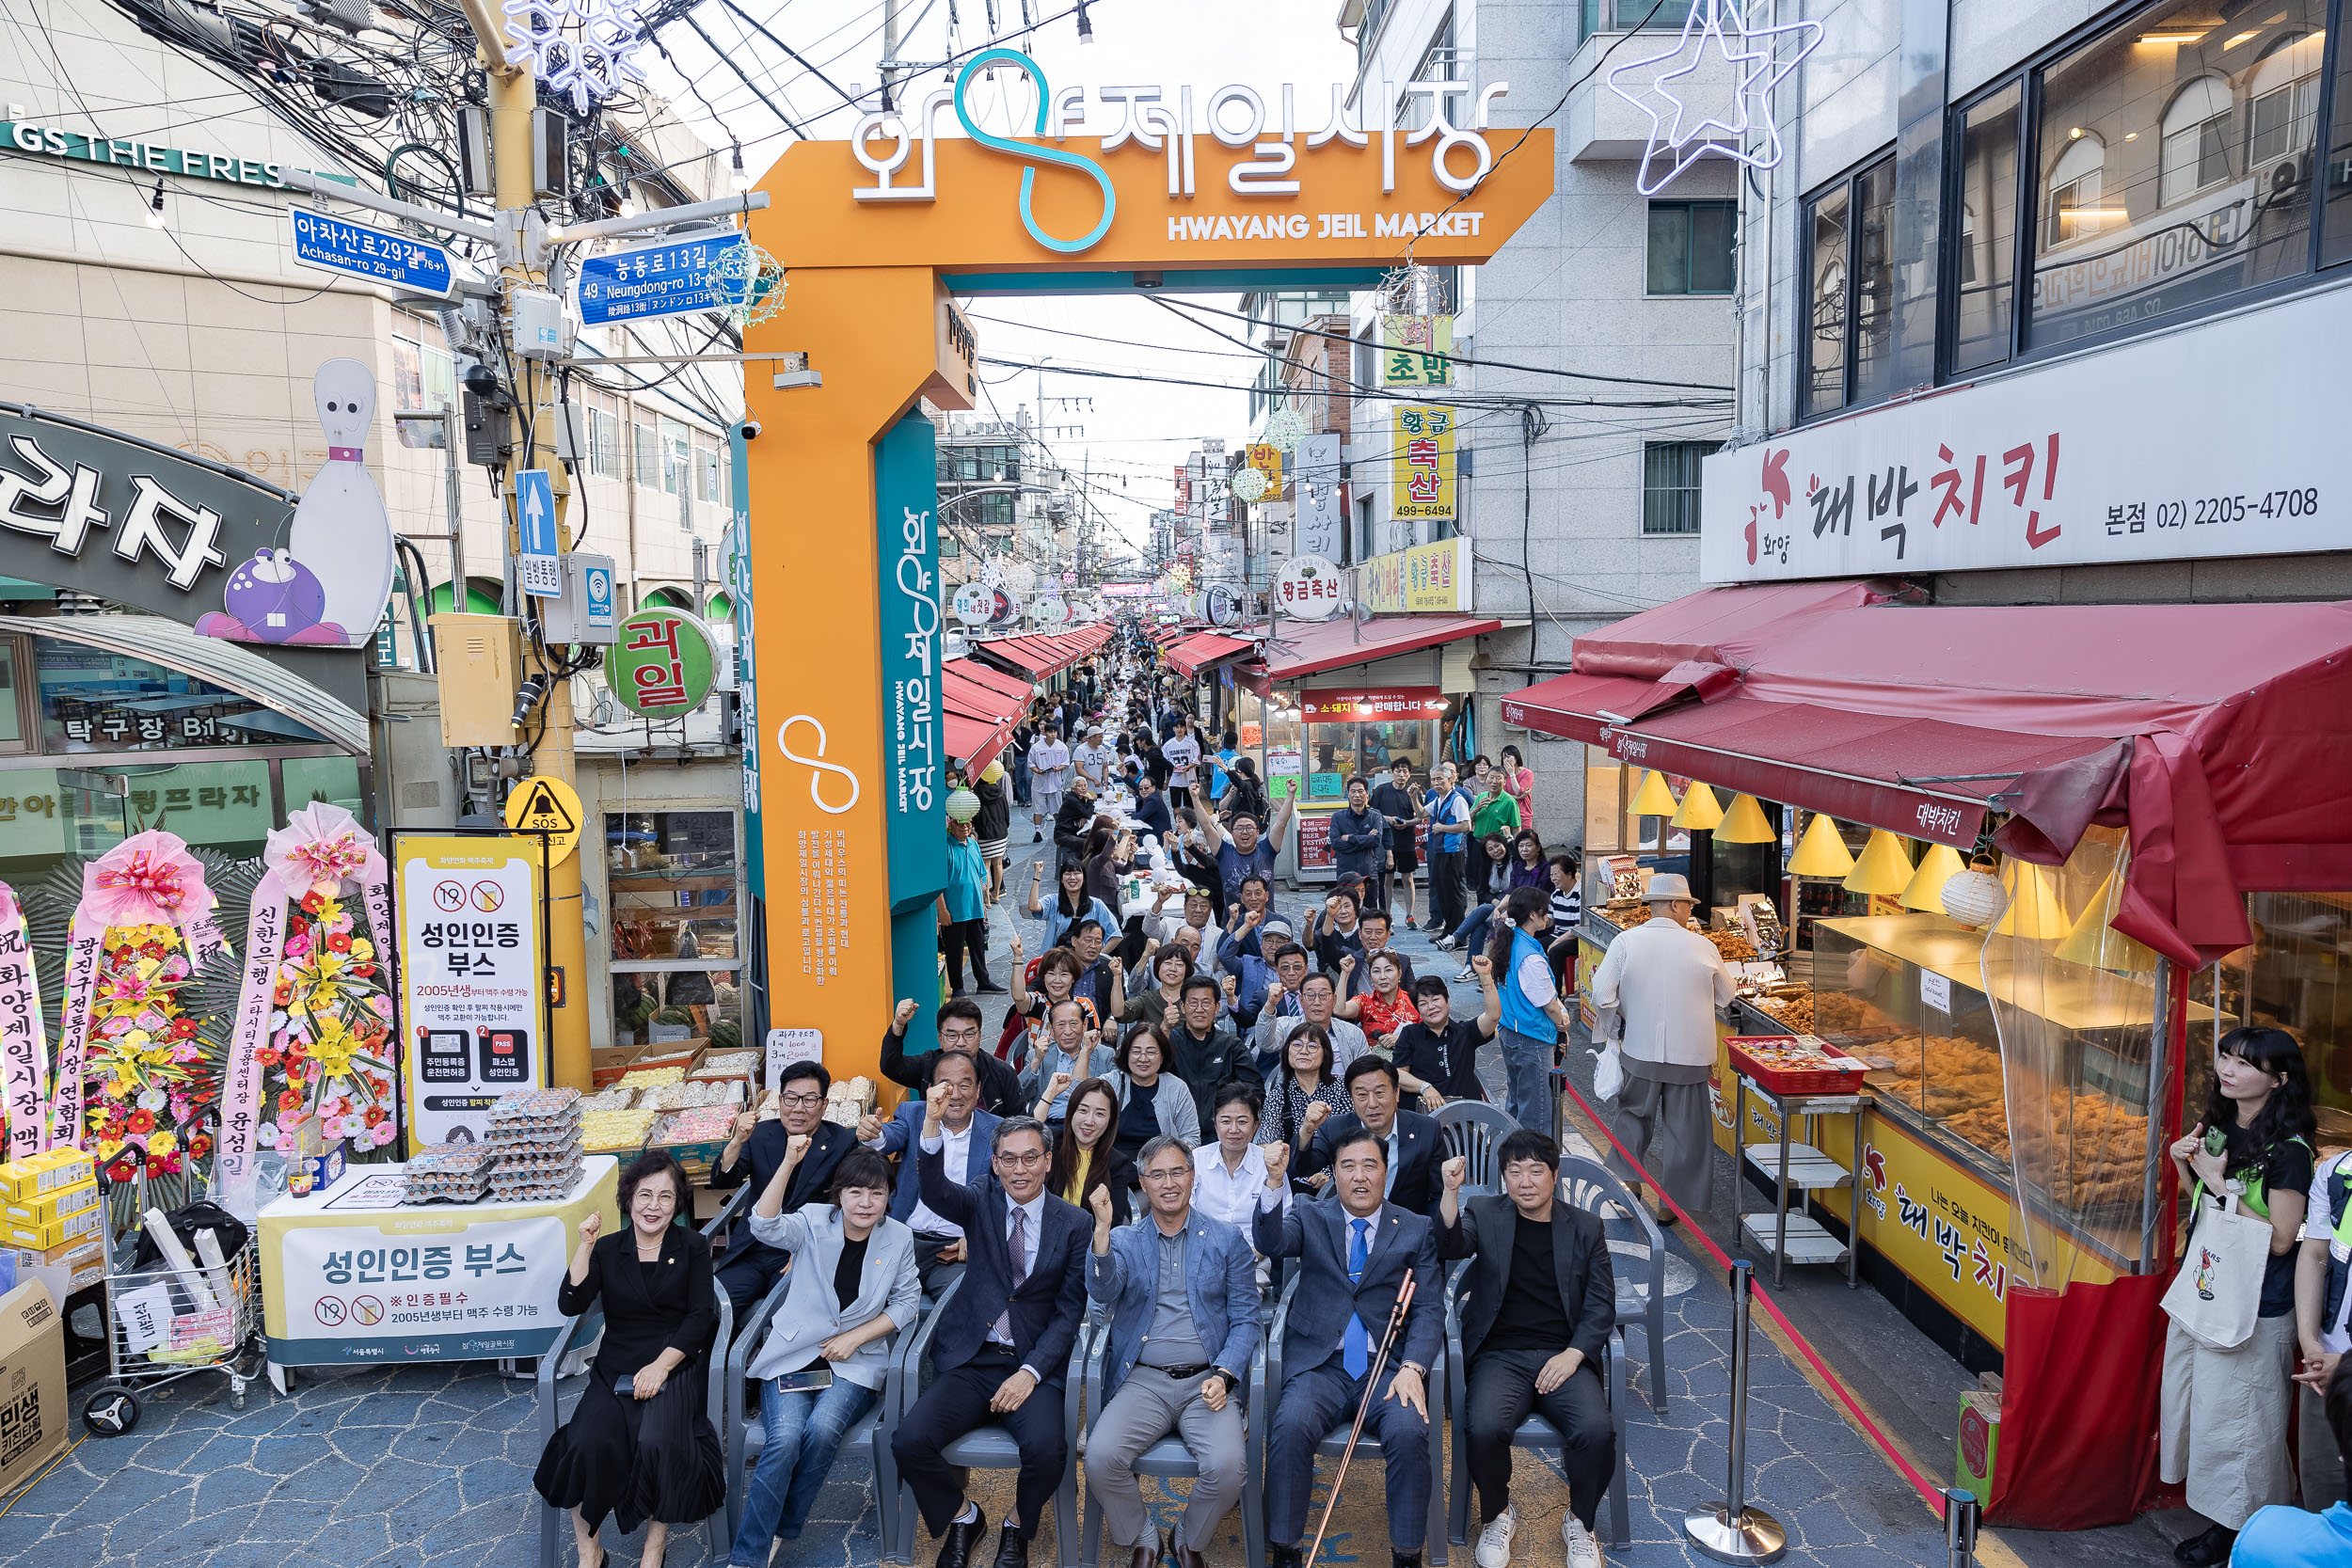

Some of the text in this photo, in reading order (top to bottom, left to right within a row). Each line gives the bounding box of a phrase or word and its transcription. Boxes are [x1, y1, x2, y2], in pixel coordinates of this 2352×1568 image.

[12, 122, 69, 155] GS
[77, 131, 170, 171] THE
[850, 48, 1509, 255] 화양제일시장
[1168, 212, 1484, 241] HWAYANG JEIL MARKET
[297, 217, 420, 270] 아차산로29길
[301, 243, 405, 279] Achasan-ro 29-gil
[615, 245, 741, 281] 능동로13길 53
[584, 282, 598, 299] 49
[606, 273, 684, 300] Neungdong-ro
[1387, 350, 1450, 385] 초밥
[1401, 409, 1450, 436] 황금
[1407, 438, 1441, 503] 축산
[1397, 505, 1452, 516] 499-6494
[1805, 432, 2061, 560] 대박치킨
[2105, 487, 2318, 535] 본점 02) 2205-4708
[1763, 533, 1790, 564] 화양
[525, 559, 557, 587] 일방통행
[1411, 548, 1453, 592] 황금축산
[1282, 578, 1338, 602] 황금축산
[378, 637, 392, 667] TH
[626, 619, 689, 709] 과일
[897, 506, 939, 812] 화양제일시장
[1375, 701, 1421, 712] 판매합니다
[66, 717, 215, 741] 탁구장 B1
[895, 680, 908, 813] HWAYANG JEIL MARKET
[1088, 753, 1104, 766] 35
[532, 818, 558, 829] SOS
[1916, 803, 1962, 835] 대박치킨
[798, 830, 808, 896] 화양제일시장의
[824, 829, 834, 877] 기성세대와
[836, 829, 847, 877] 뫼비우스의
[249, 906, 279, 987] 신한은행
[421, 923, 520, 948] 성인인증
[840, 929, 850, 948] 현대
[448, 952, 496, 978] 부스
[417, 984, 529, 998] 2005년생부터 맥주 수령 가능
[423, 1004, 450, 1012] 성인인증
[452, 1004, 466, 1012] 확인
[467, 1004, 473, 1012] 후
[474, 1004, 488, 1012] 팔찌
[437, 1013, 510, 1022] 맥주 교환이 가능합니다.
[419, 1026, 425, 1037] 1
[479, 1026, 486, 1037] 2
[0, 963, 44, 1158] 화양제일시장 맥
[426, 1057, 466, 1066] 주민등록증
[492, 1057, 516, 1066] 패스앱
[787, 1051, 810, 1060] 2000
[426, 1068, 466, 1077] 운전면허증
[488, 1068, 519, 1077] 성인인증
[53, 1082, 80, 1142] 연합회
[441, 1099, 469, 1107] 성인인증
[469, 1099, 484, 1107] 팔찌
[222, 1111, 252, 1177] 윤성일
[1866, 1188, 1886, 1221] 화양
[1931, 1186, 1949, 1212] 나는
[1950, 1201, 1969, 1226] 오늘
[1971, 1214, 2000, 1246] 치킨이
[322, 1243, 527, 1285] 성인인증 부스
[391, 1304, 539, 1323] 2005년생부터 맥주 수령 가능
[353, 1347, 385, 1356] 서울특별시
[2, 1415, 41, 1453] 키친타월
